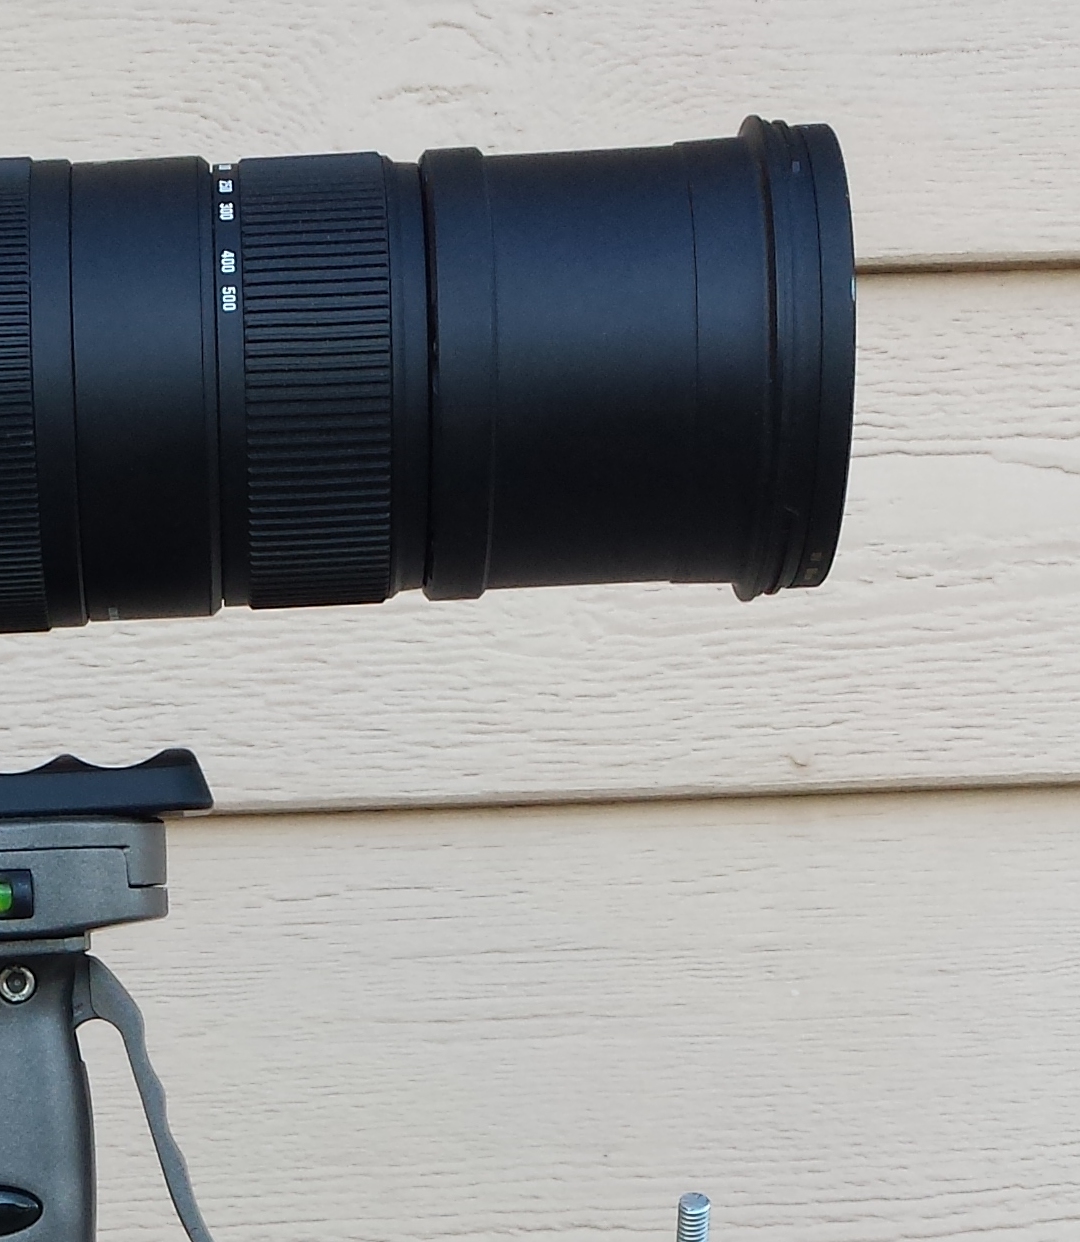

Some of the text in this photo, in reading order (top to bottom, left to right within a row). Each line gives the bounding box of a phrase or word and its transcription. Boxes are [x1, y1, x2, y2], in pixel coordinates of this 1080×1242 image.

[219, 202, 234, 220] 300
[221, 250, 236, 273] 400
[222, 286, 237, 312] 500
